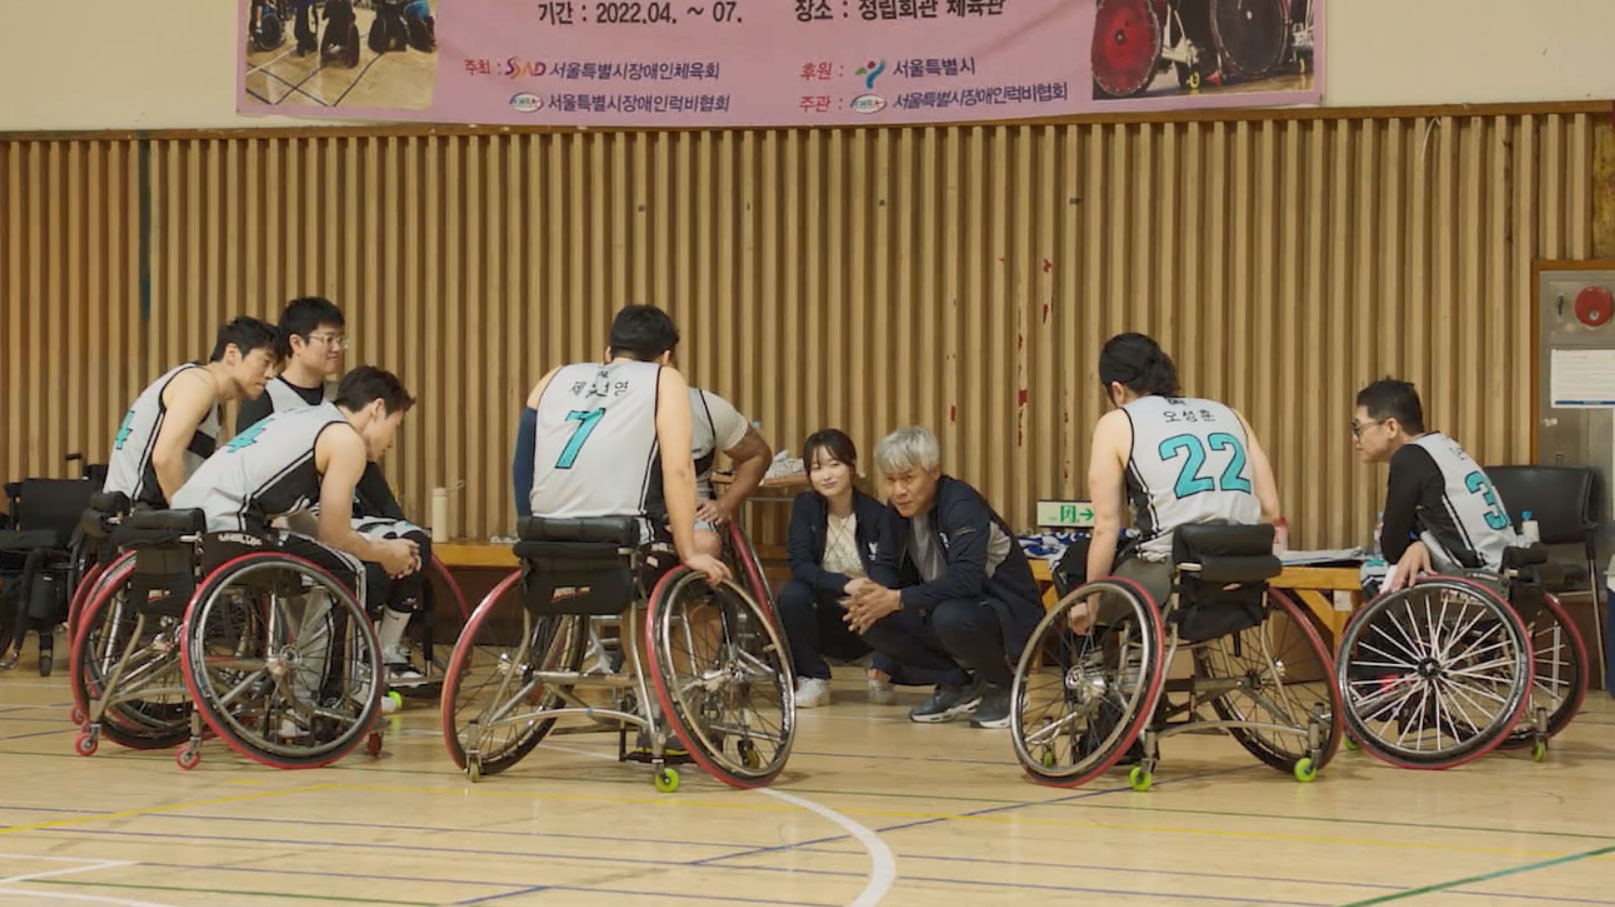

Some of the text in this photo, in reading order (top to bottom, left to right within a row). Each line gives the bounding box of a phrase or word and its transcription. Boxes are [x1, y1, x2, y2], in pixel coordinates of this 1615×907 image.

[538, 1, 573, 25] 기간
[596, 2, 677, 24] 2022.04.
[713, 1, 742, 23] 07.
[795, 0, 833, 22] 장소
[464, 59, 491, 76] 주최
[550, 62, 720, 80] 서울특별시장애인체육회
[801, 61, 832, 80] 후원
[893, 57, 976, 78] 서울특별시
[548, 94, 730, 113] 서울특별시장애인럭비협회
[800, 95, 831, 113] 주관
[893, 81, 1068, 110] 서울특별시장애인럭비협회
[554, 407, 606, 470] 7
[1158, 432, 1251, 500] 22
[1464, 470, 1511, 531] 3
